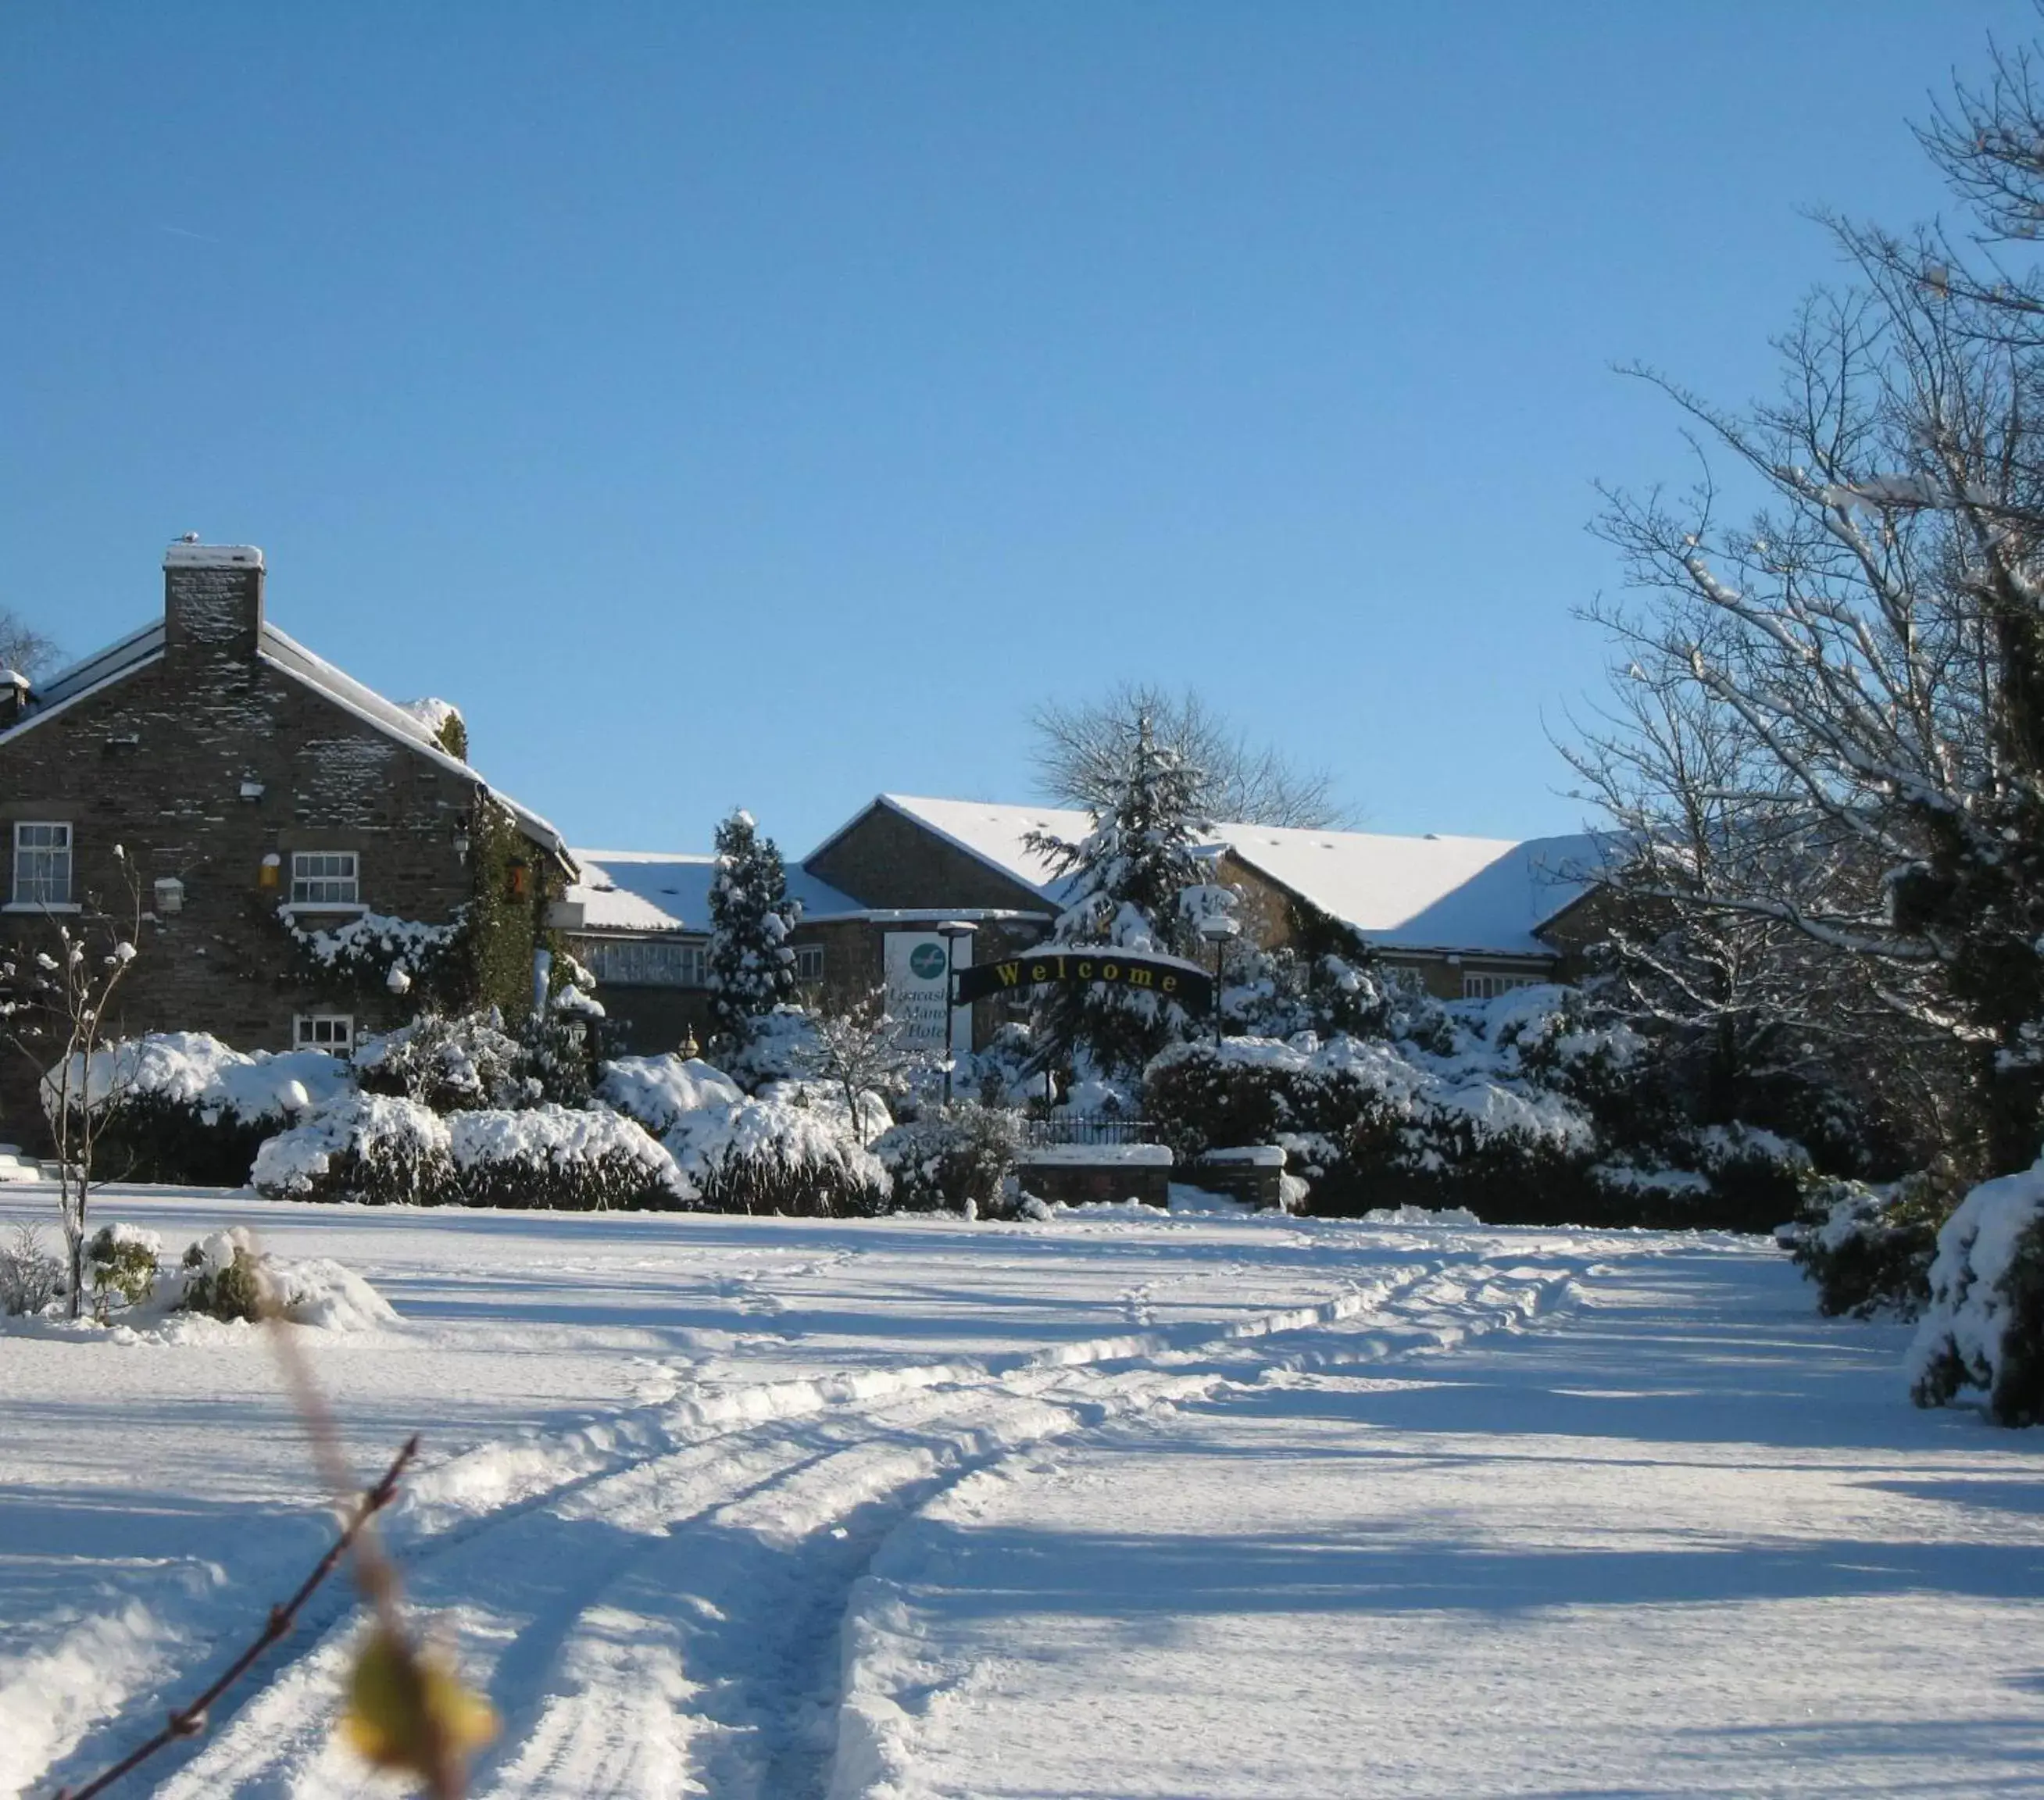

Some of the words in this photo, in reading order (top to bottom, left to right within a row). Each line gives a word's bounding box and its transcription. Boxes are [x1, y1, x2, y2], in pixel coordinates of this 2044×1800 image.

[995, 956, 1177, 992] Welcome
[905, 1006, 948, 1020] Mano
[907, 1024, 948, 1038] Hote
